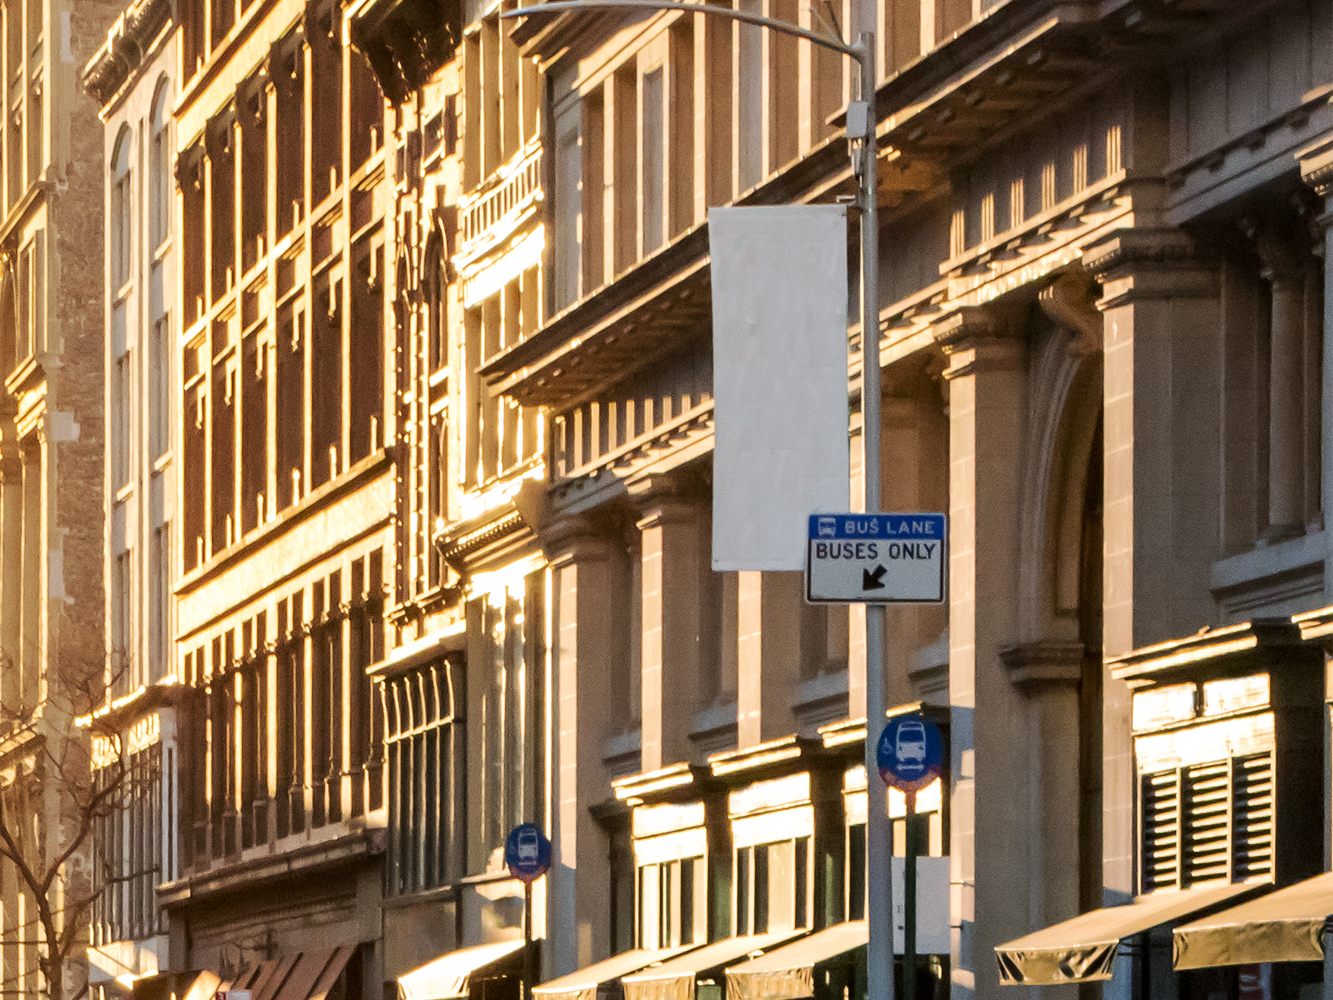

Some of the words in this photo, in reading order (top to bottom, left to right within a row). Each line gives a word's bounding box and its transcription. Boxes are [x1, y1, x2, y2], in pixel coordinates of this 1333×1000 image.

[845, 519, 879, 535] BUS
[886, 520, 935, 535] LANE
[816, 543, 878, 559] BUSES
[889, 543, 936, 560] ONLY
